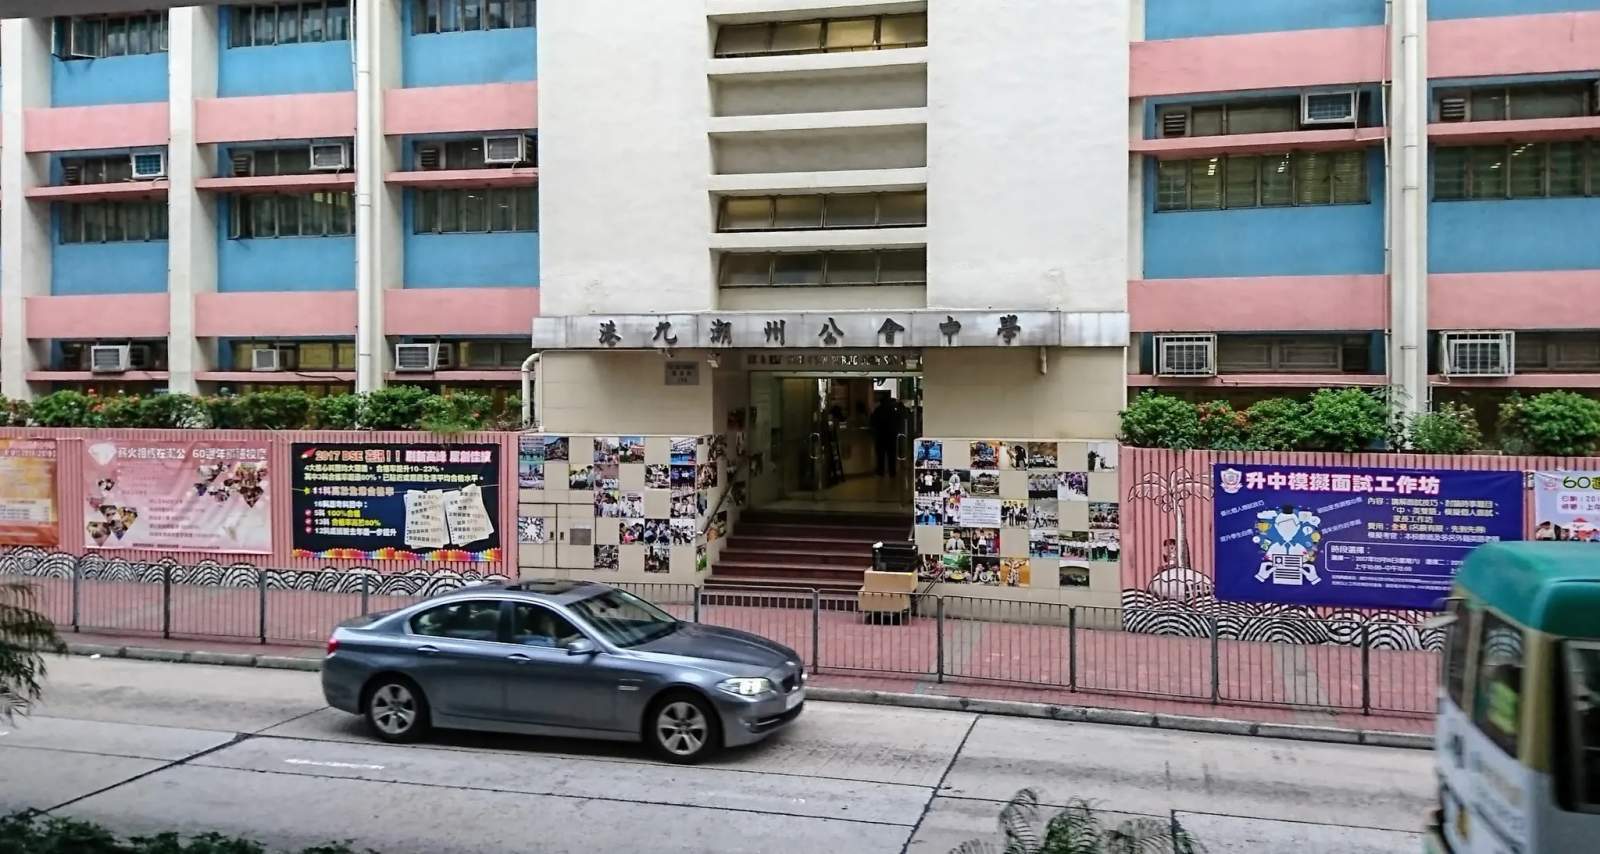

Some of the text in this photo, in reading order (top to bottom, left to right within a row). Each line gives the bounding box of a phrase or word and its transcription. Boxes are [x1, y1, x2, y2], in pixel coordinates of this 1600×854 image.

[599, 315, 1021, 346] 港九潮州公會中學
[315, 450, 341, 461] 2017
[341, 450, 363, 461] DSE
[1245, 471, 1441, 495] 升中模擬面試工作坊
